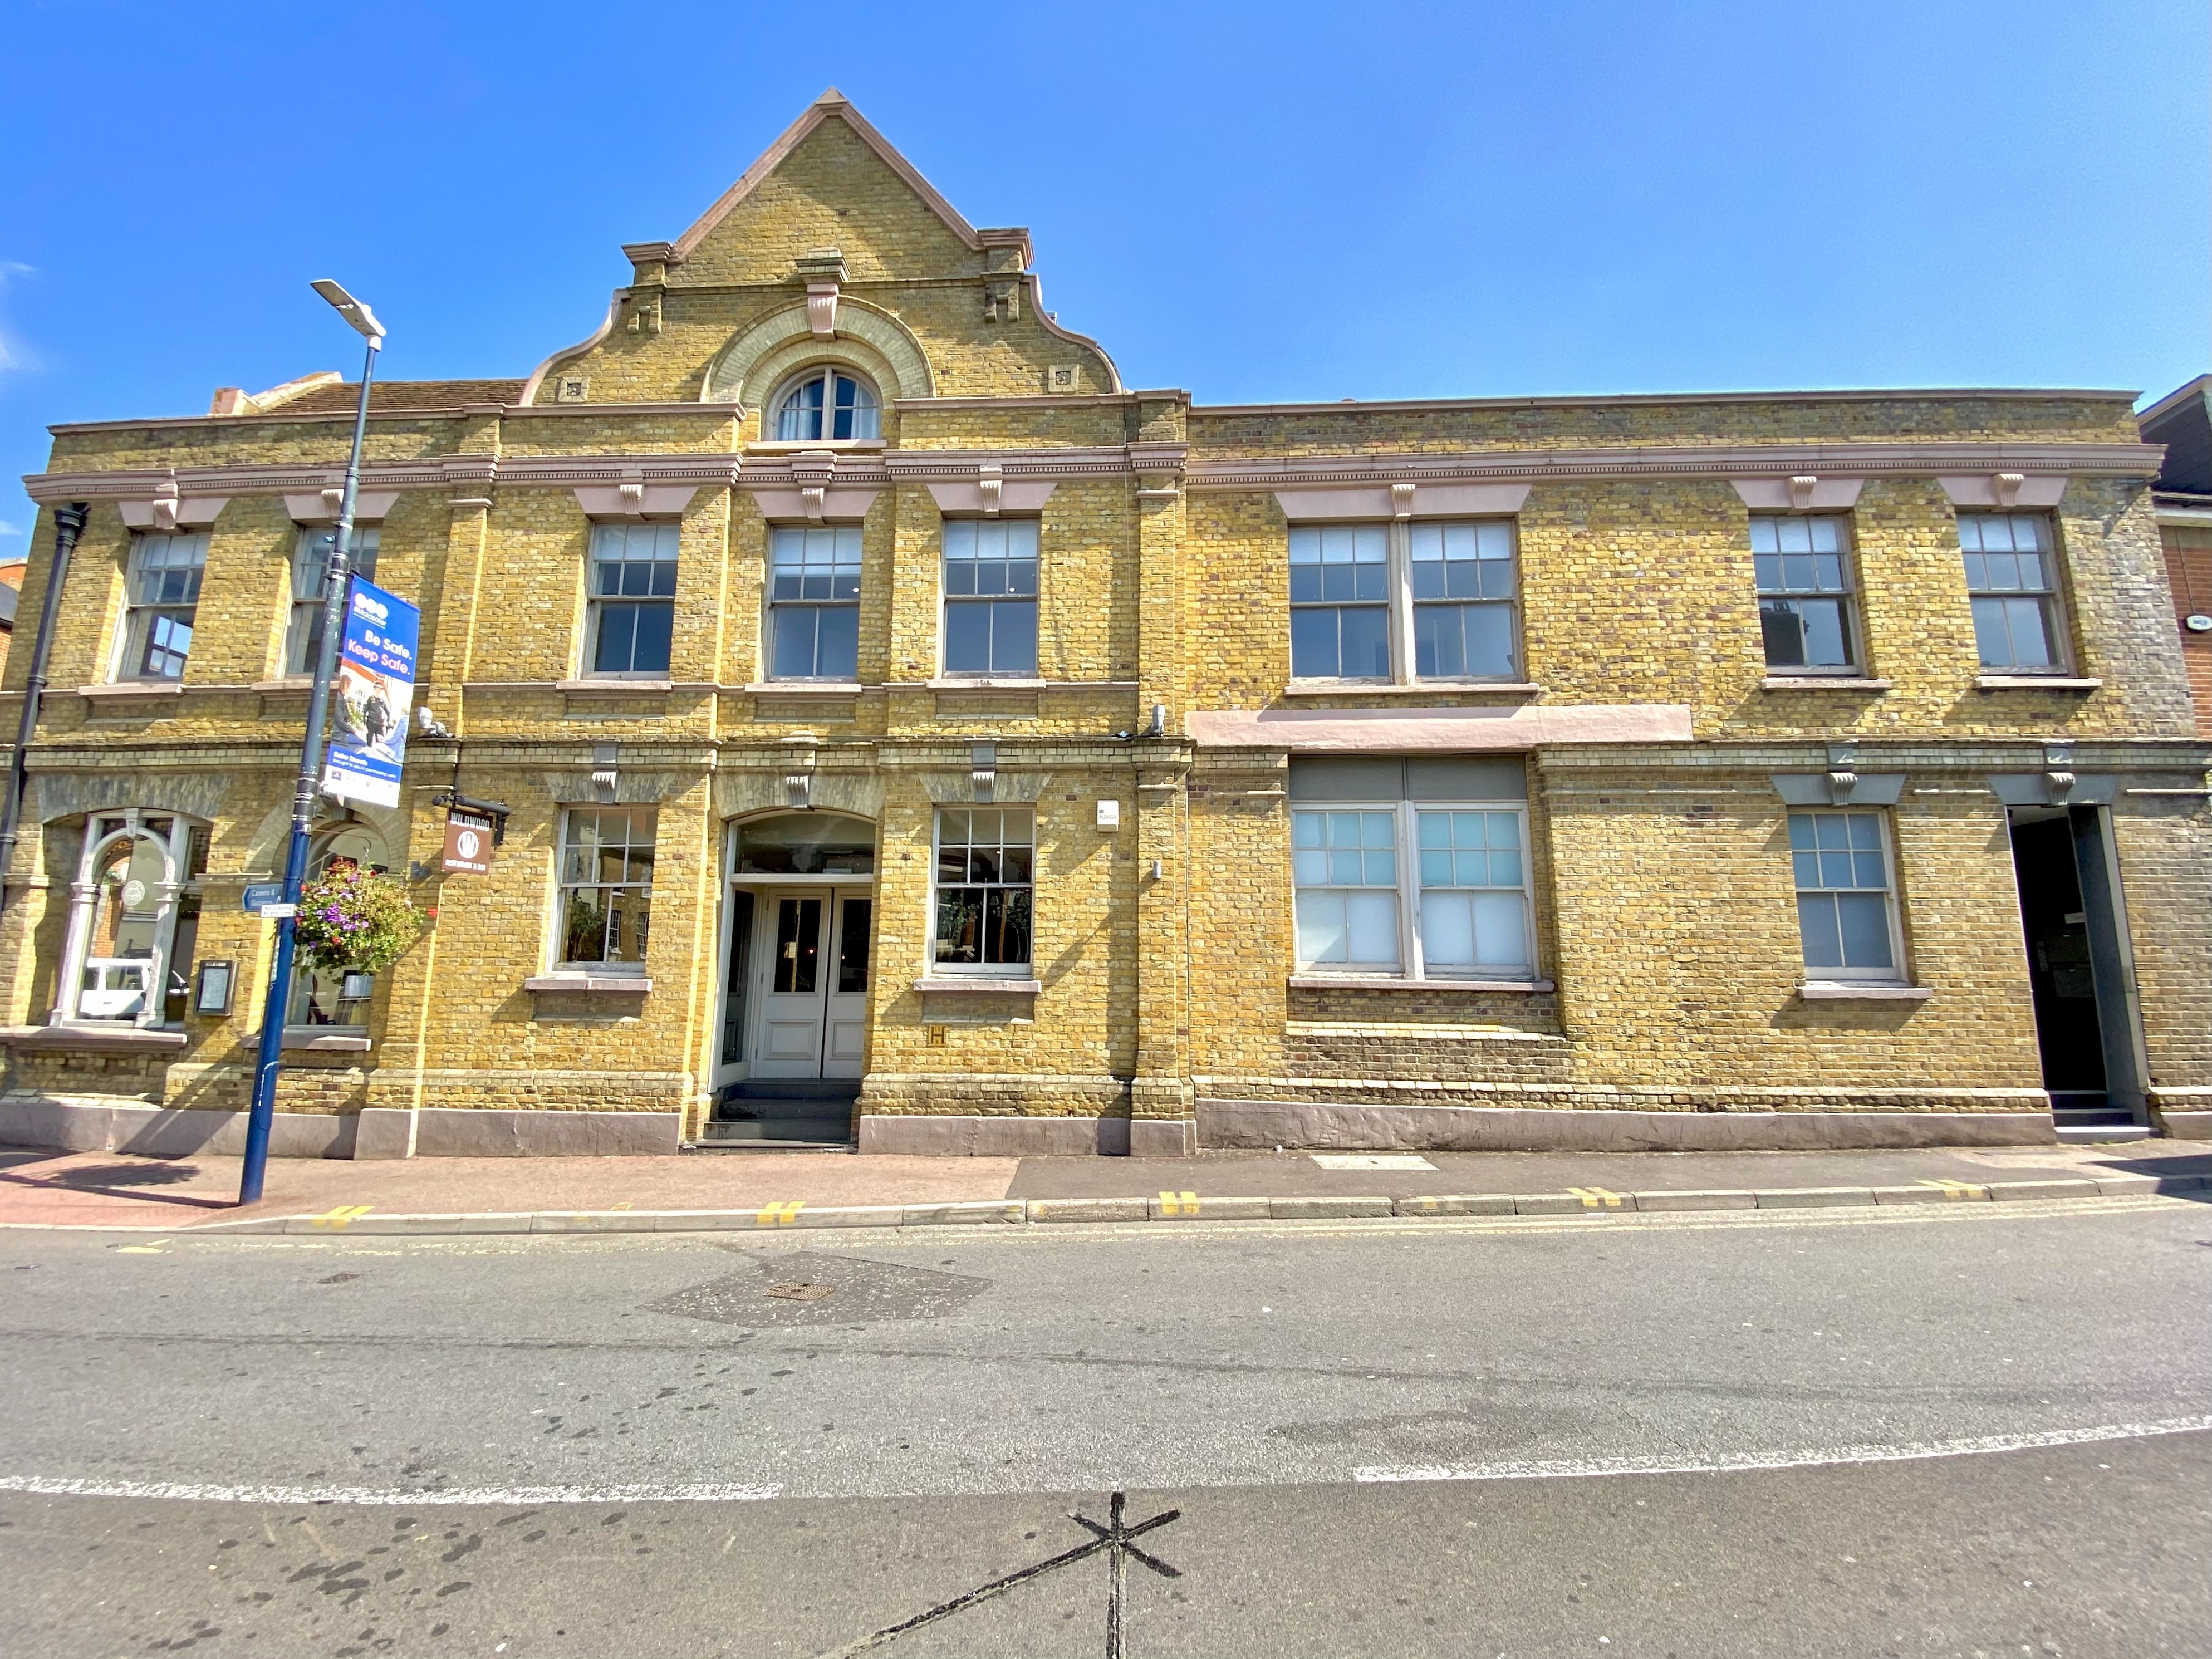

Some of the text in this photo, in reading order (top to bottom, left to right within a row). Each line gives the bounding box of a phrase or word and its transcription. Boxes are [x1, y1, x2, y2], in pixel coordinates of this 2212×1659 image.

[348, 639, 410, 675] Keep Safe.
[365, 629, 413, 660] Be Safe.
[450, 812, 490, 832] WILDWOOD
[931, 1026, 945, 1044] H
